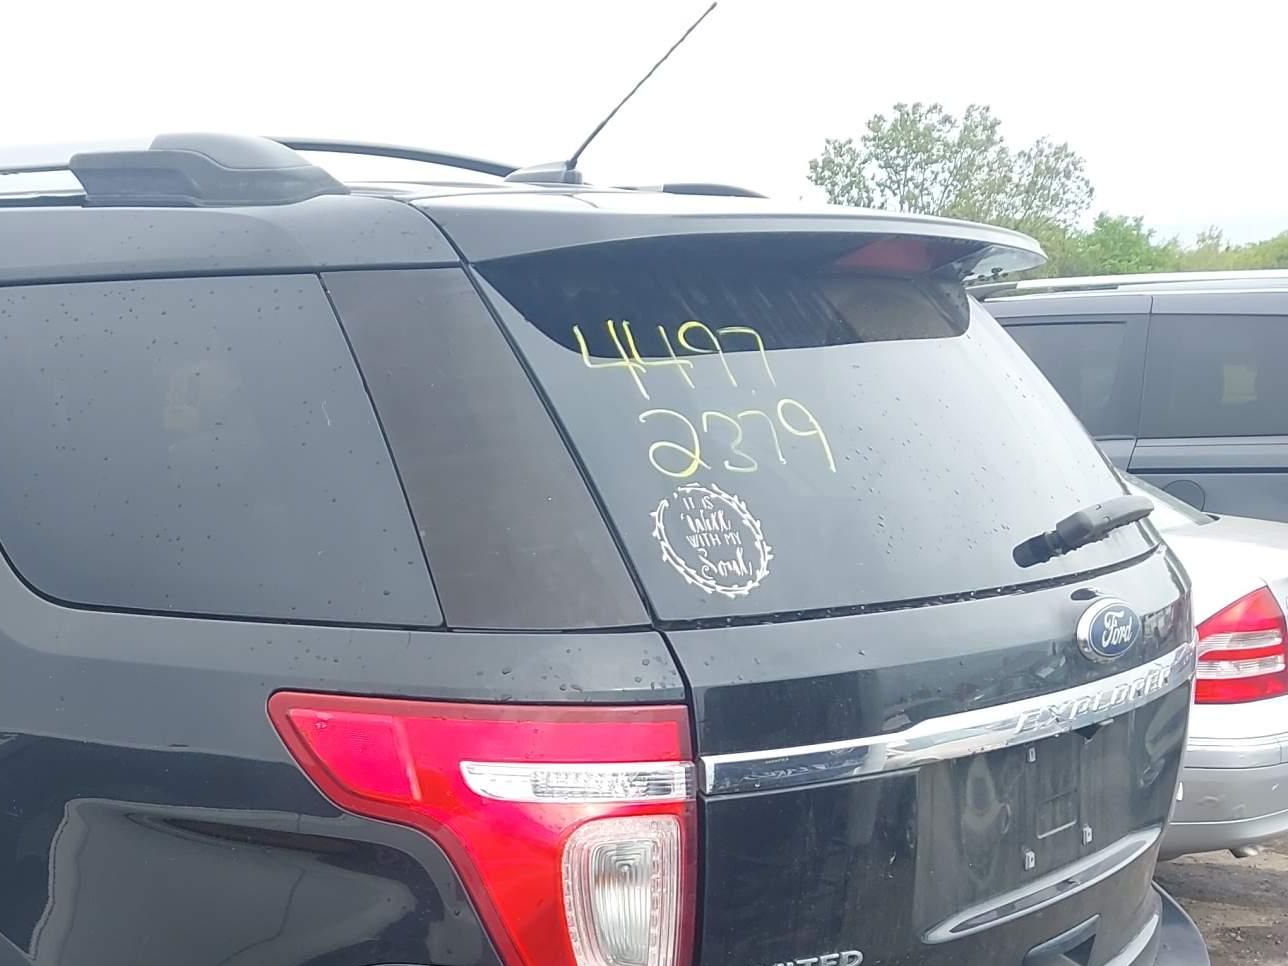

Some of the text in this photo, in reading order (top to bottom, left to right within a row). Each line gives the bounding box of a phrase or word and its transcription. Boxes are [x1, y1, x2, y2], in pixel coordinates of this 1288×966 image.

[572, 319, 777, 400] 4497
[638, 398, 838, 478] 2379
[685, 531, 743, 548] WITH MY
[1101, 610, 1134, 649] Ford
[1014, 664, 1172, 735] EXPLORER
